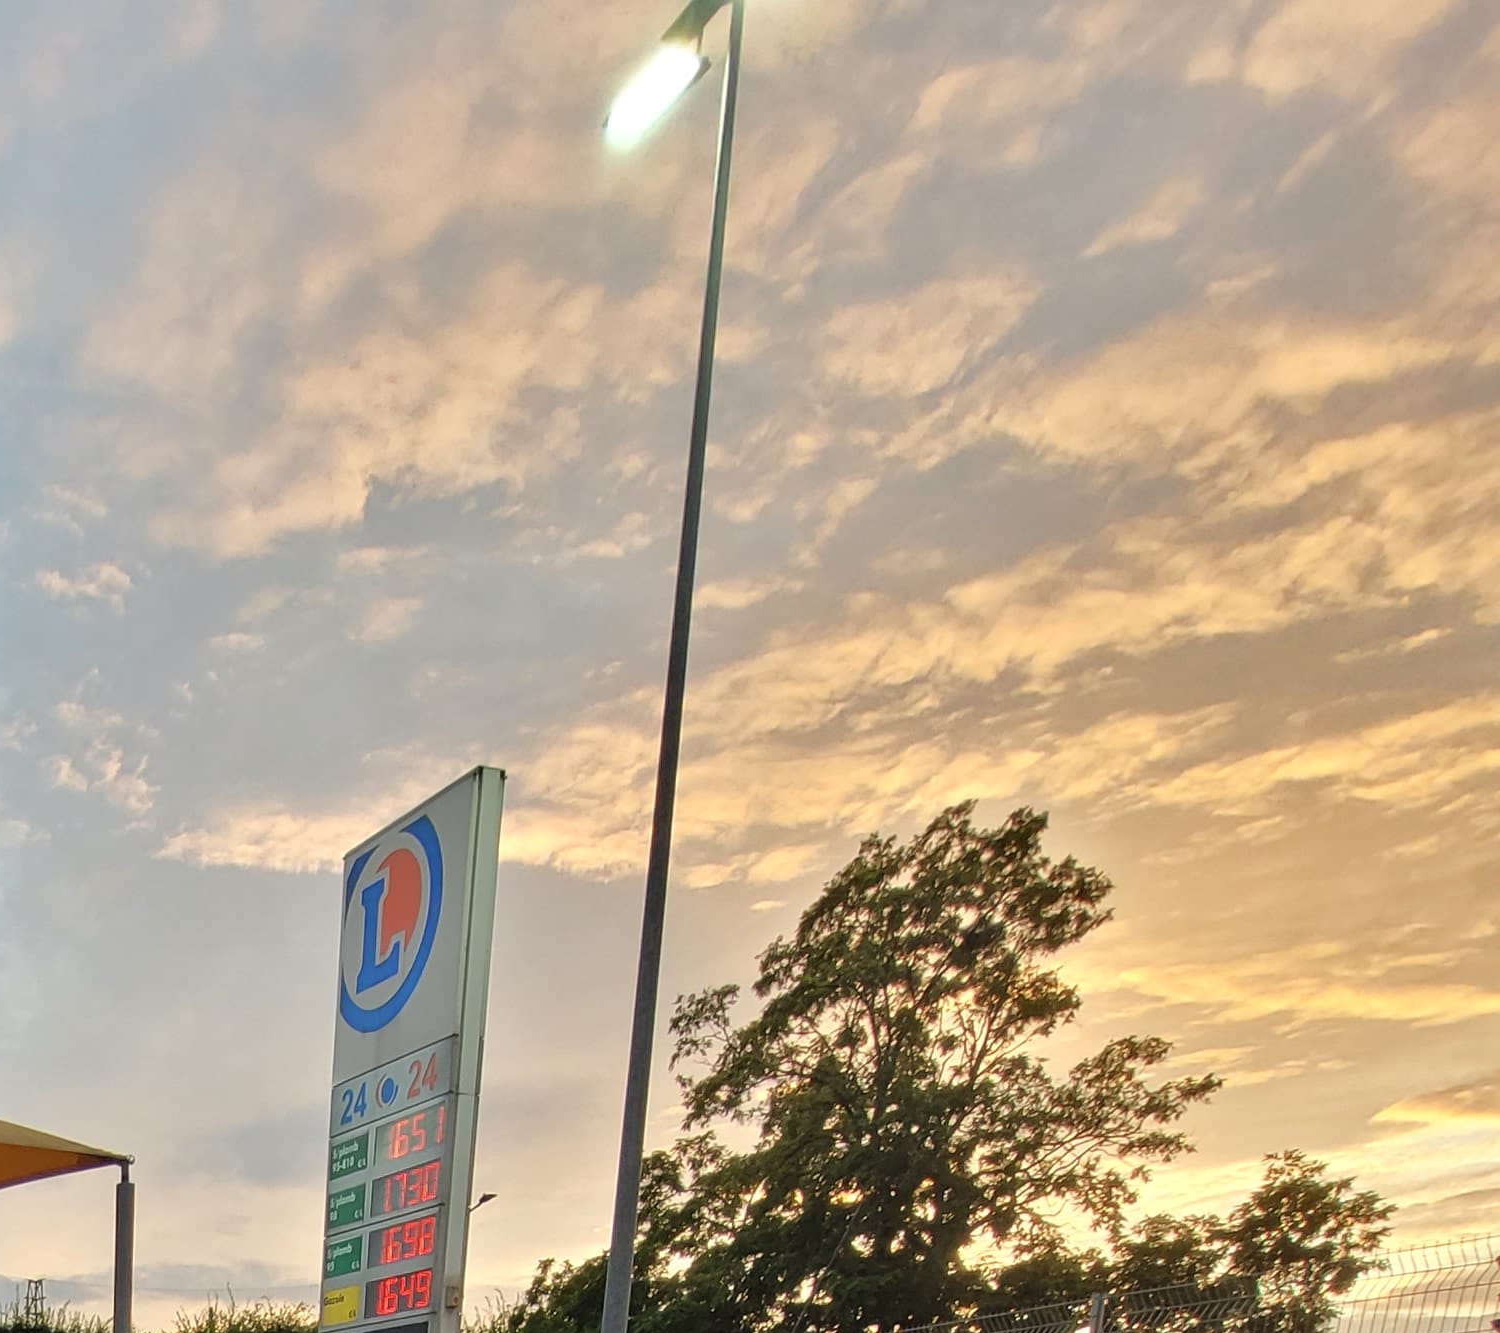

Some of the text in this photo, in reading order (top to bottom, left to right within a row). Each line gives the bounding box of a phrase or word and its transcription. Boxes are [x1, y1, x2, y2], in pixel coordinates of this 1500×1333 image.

[340, 1052, 438, 1126] 24 24
[383, 1161, 441, 1213] 1730
[380, 1216, 437, 1265] 1698
[376, 1270, 432, 1315] 1649
